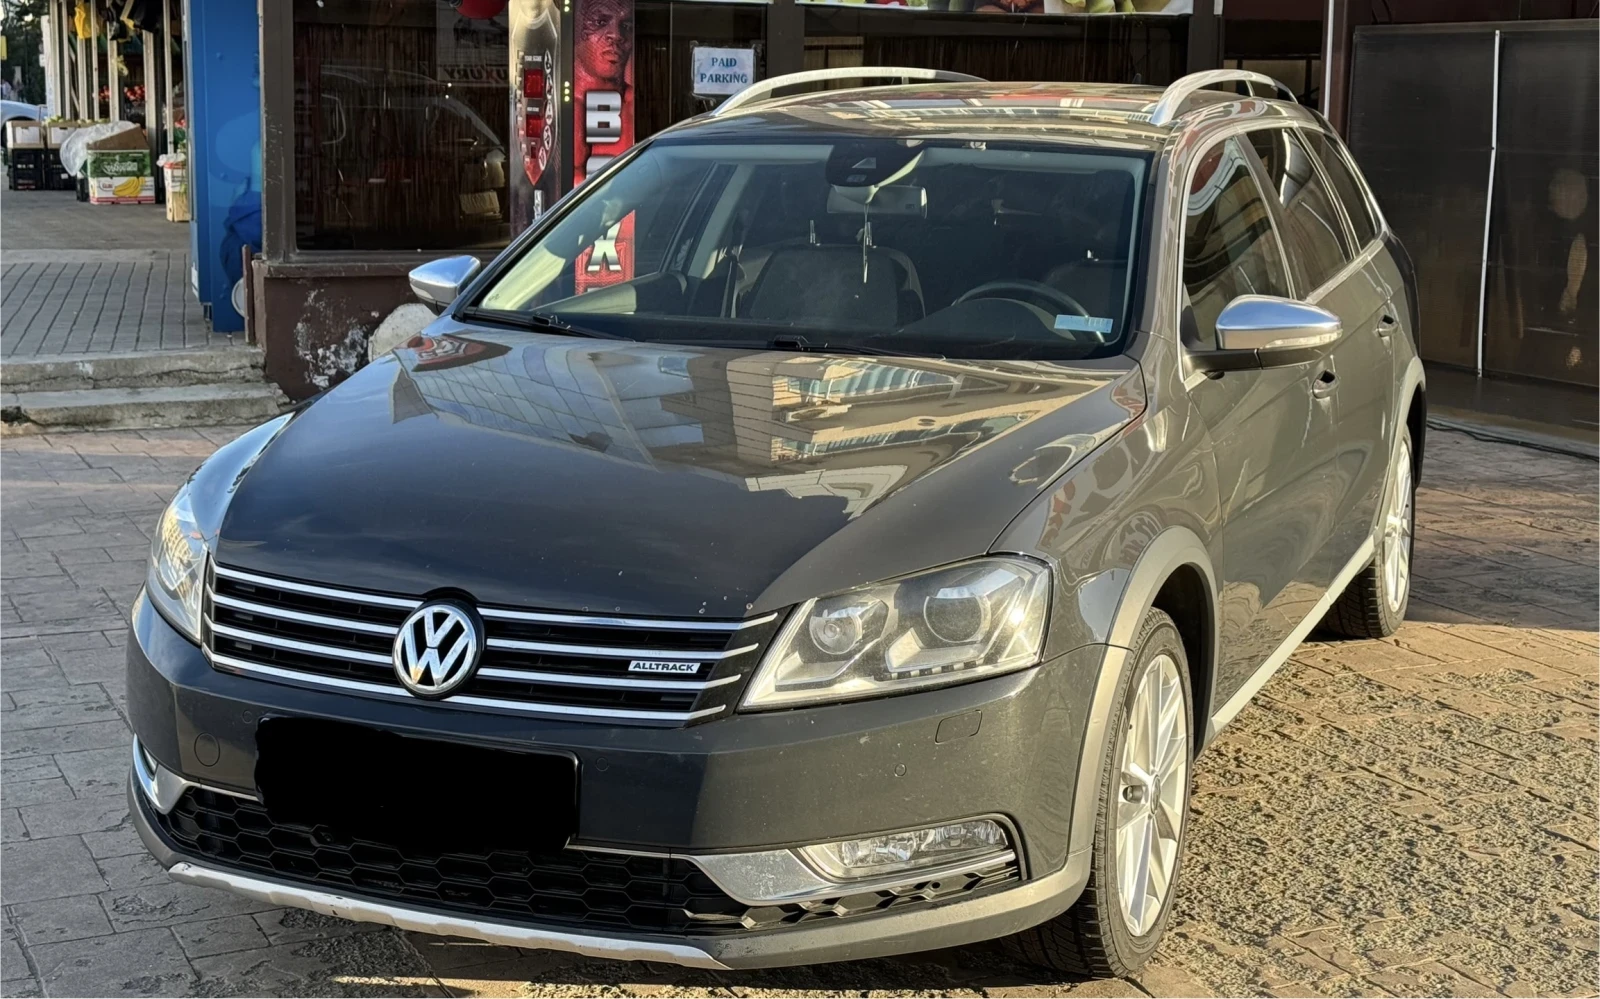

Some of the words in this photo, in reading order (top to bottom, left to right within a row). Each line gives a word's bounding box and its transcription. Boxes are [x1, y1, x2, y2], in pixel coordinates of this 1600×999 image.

[711, 57, 737, 68] PAID
[699, 72, 748, 84] PARKING
[399, 606, 473, 690] VW
[633, 662, 694, 672] ALLTRACK
